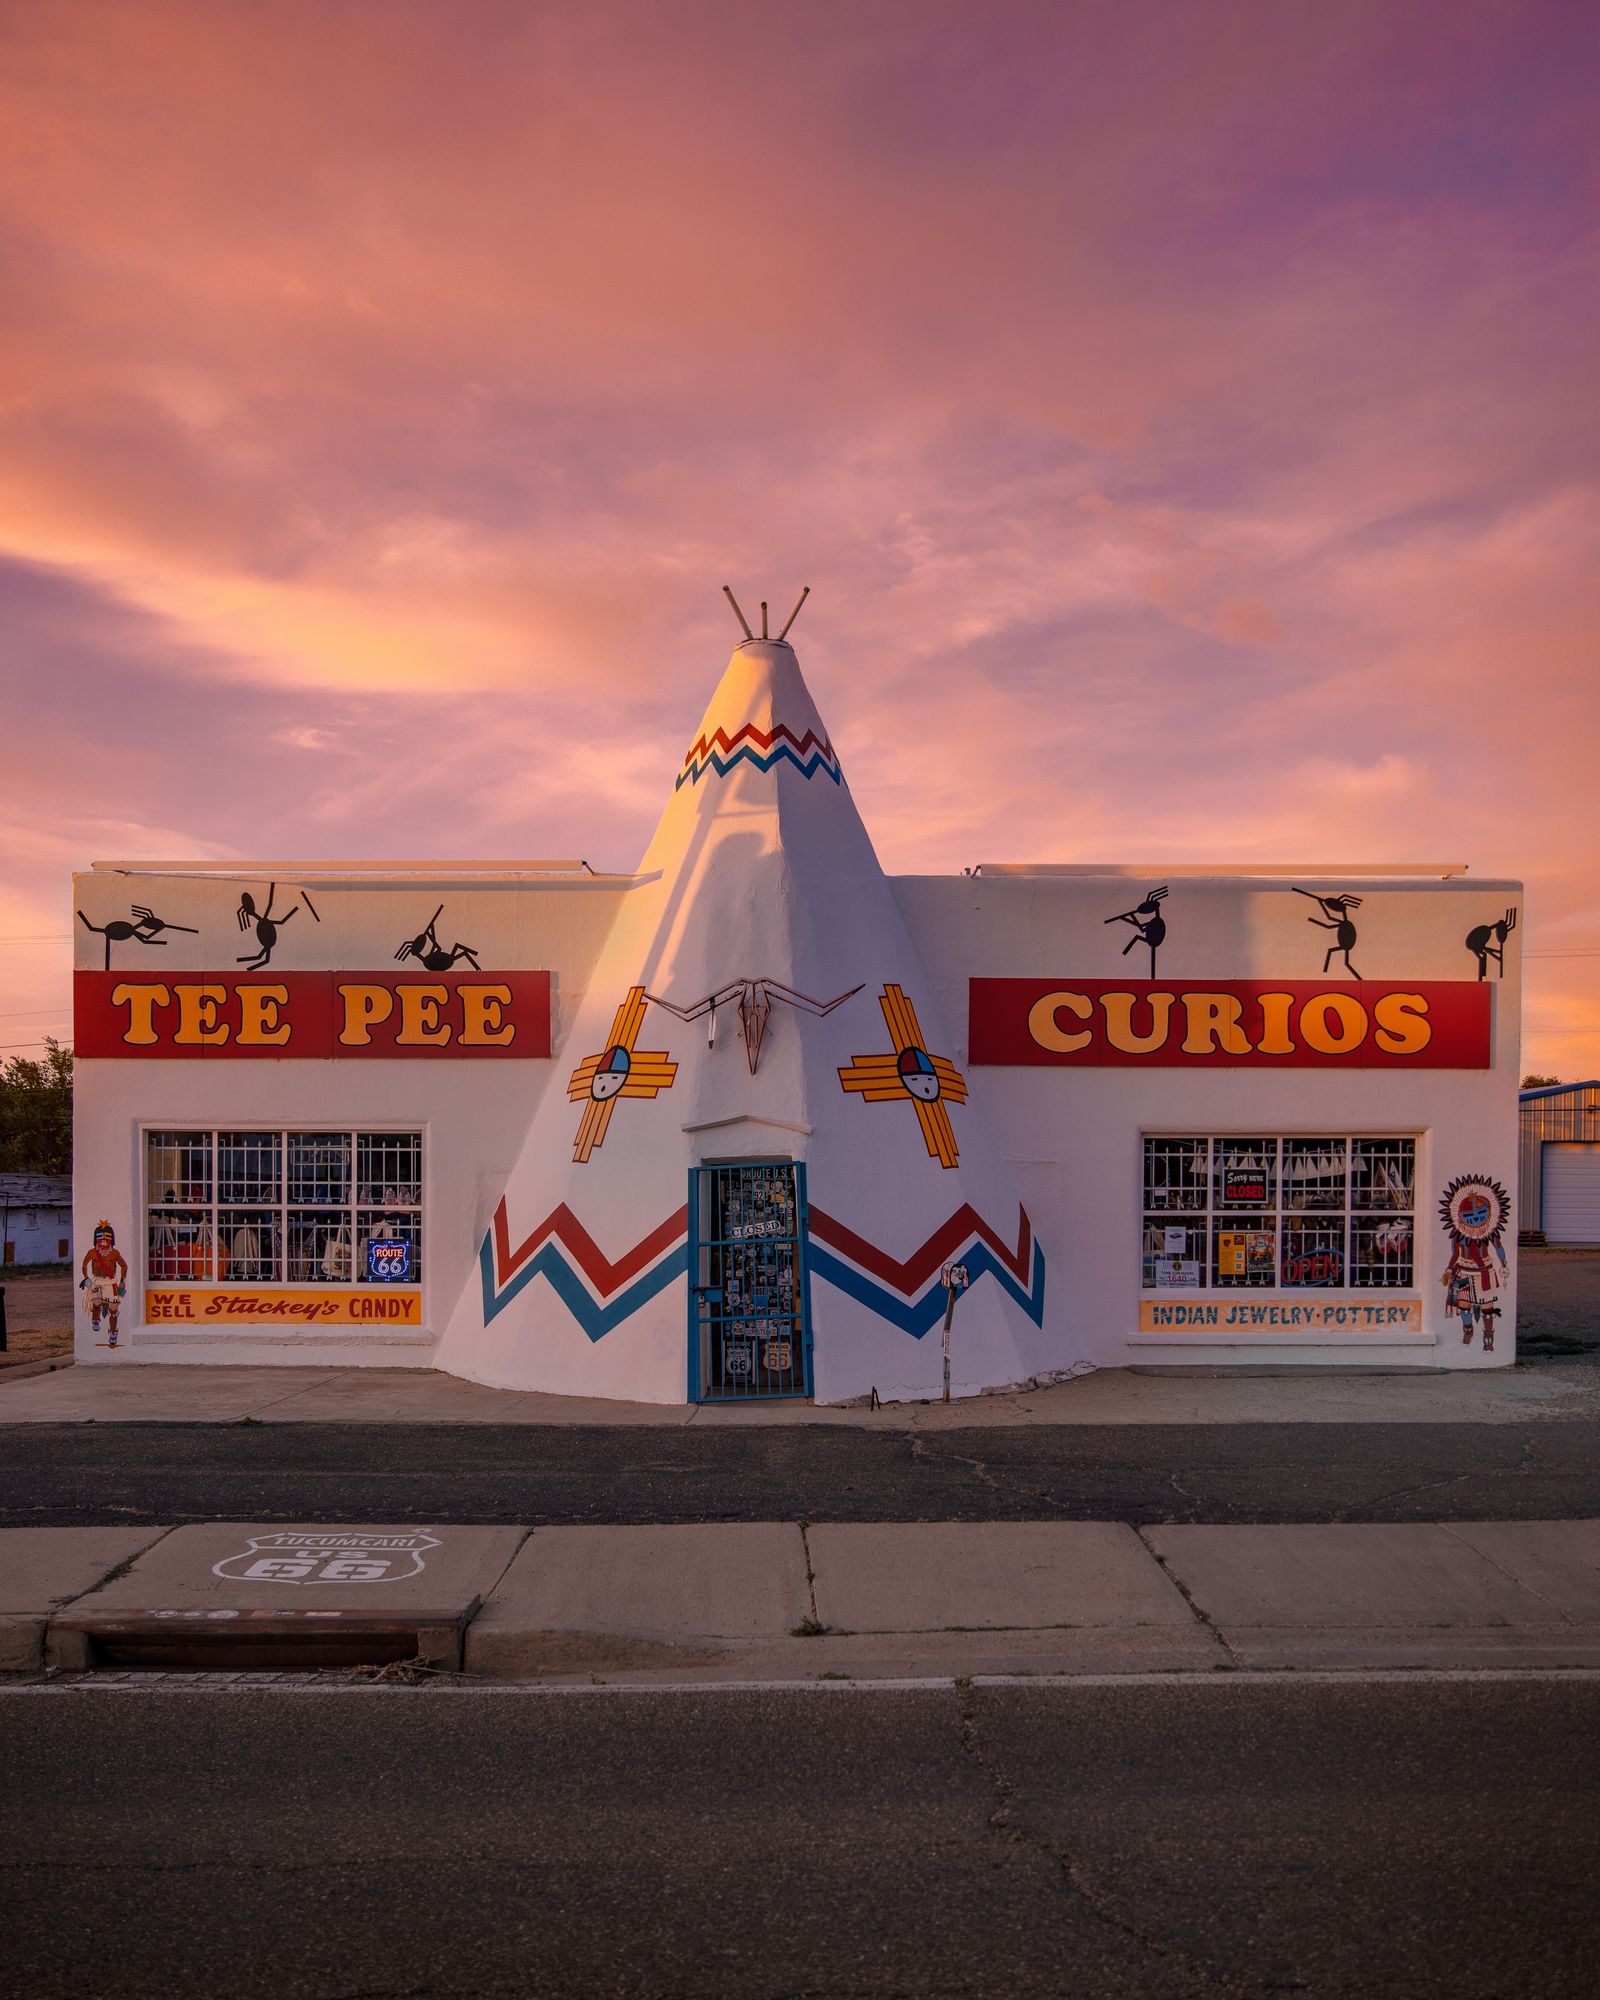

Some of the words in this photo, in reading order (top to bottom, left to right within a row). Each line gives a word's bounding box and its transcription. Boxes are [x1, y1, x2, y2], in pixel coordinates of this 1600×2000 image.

[110, 983, 292, 1046] TEE
[338, 983, 516, 1047] PEE
[1028, 991, 1432, 1055] CURIOS
[1227, 1172, 1248, 1184] Sorry
[1226, 1185, 1265, 1199] CLOSED
[731, 1221, 781, 1238] CLOSED
[376, 1248, 403, 1257] ROUTE
[378, 1257, 402, 1274] 66
[1281, 1255, 1339, 1283] OPEN
[154, 1294, 191, 1305] WE
[151, 1306, 195, 1318] SELL
[205, 1296, 340, 1320] Stuckey's
[350, 1298, 414, 1318] CANDY
[1153, 1306, 1219, 1325] INDIAN
[1225, 1306, 1315, 1324] JEWELRY
[1323, 1306, 1410, 1324] POTTERY
[730, 1360, 746, 1371] 66
[769, 1353, 788, 1367] 66
[273, 1537, 417, 1547] TUCUMCARI
[295, 1550, 369, 1559] US
[243, 1558, 392, 1579] 66
